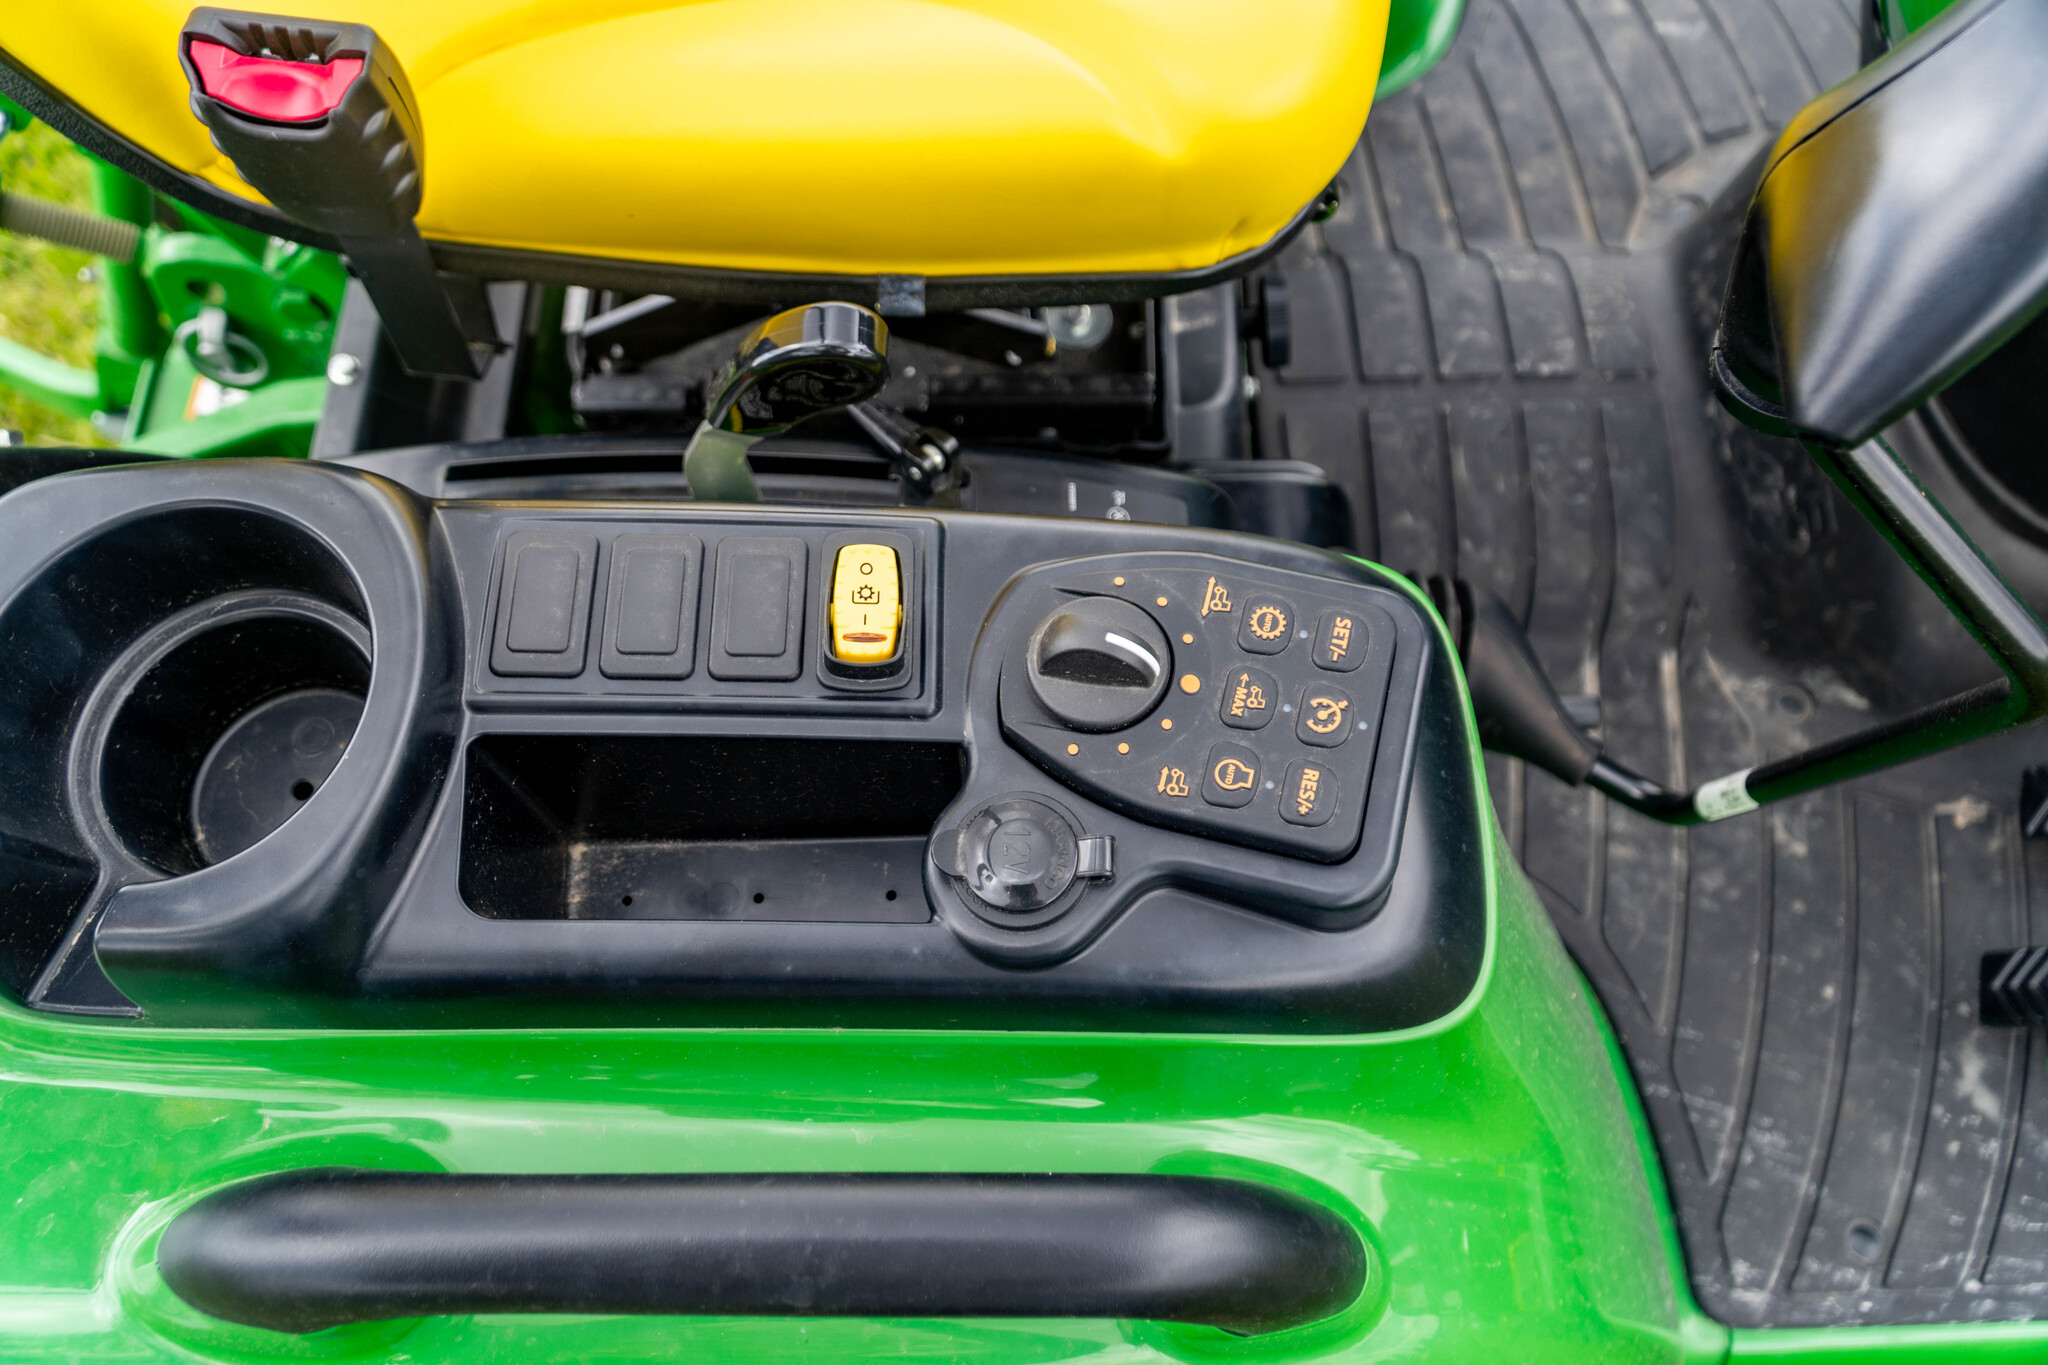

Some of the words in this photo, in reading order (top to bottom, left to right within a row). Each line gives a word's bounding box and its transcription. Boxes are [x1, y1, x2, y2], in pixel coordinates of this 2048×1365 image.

[1263, 612, 1274, 633] AUTO
[1329, 617, 1352, 662] SET/-
[1230, 687, 1247, 717] MAX
[1225, 763, 1236, 785] AUTO
[1297, 768, 1320, 815] RES/+
[1003, 827, 1032, 875] 12V
